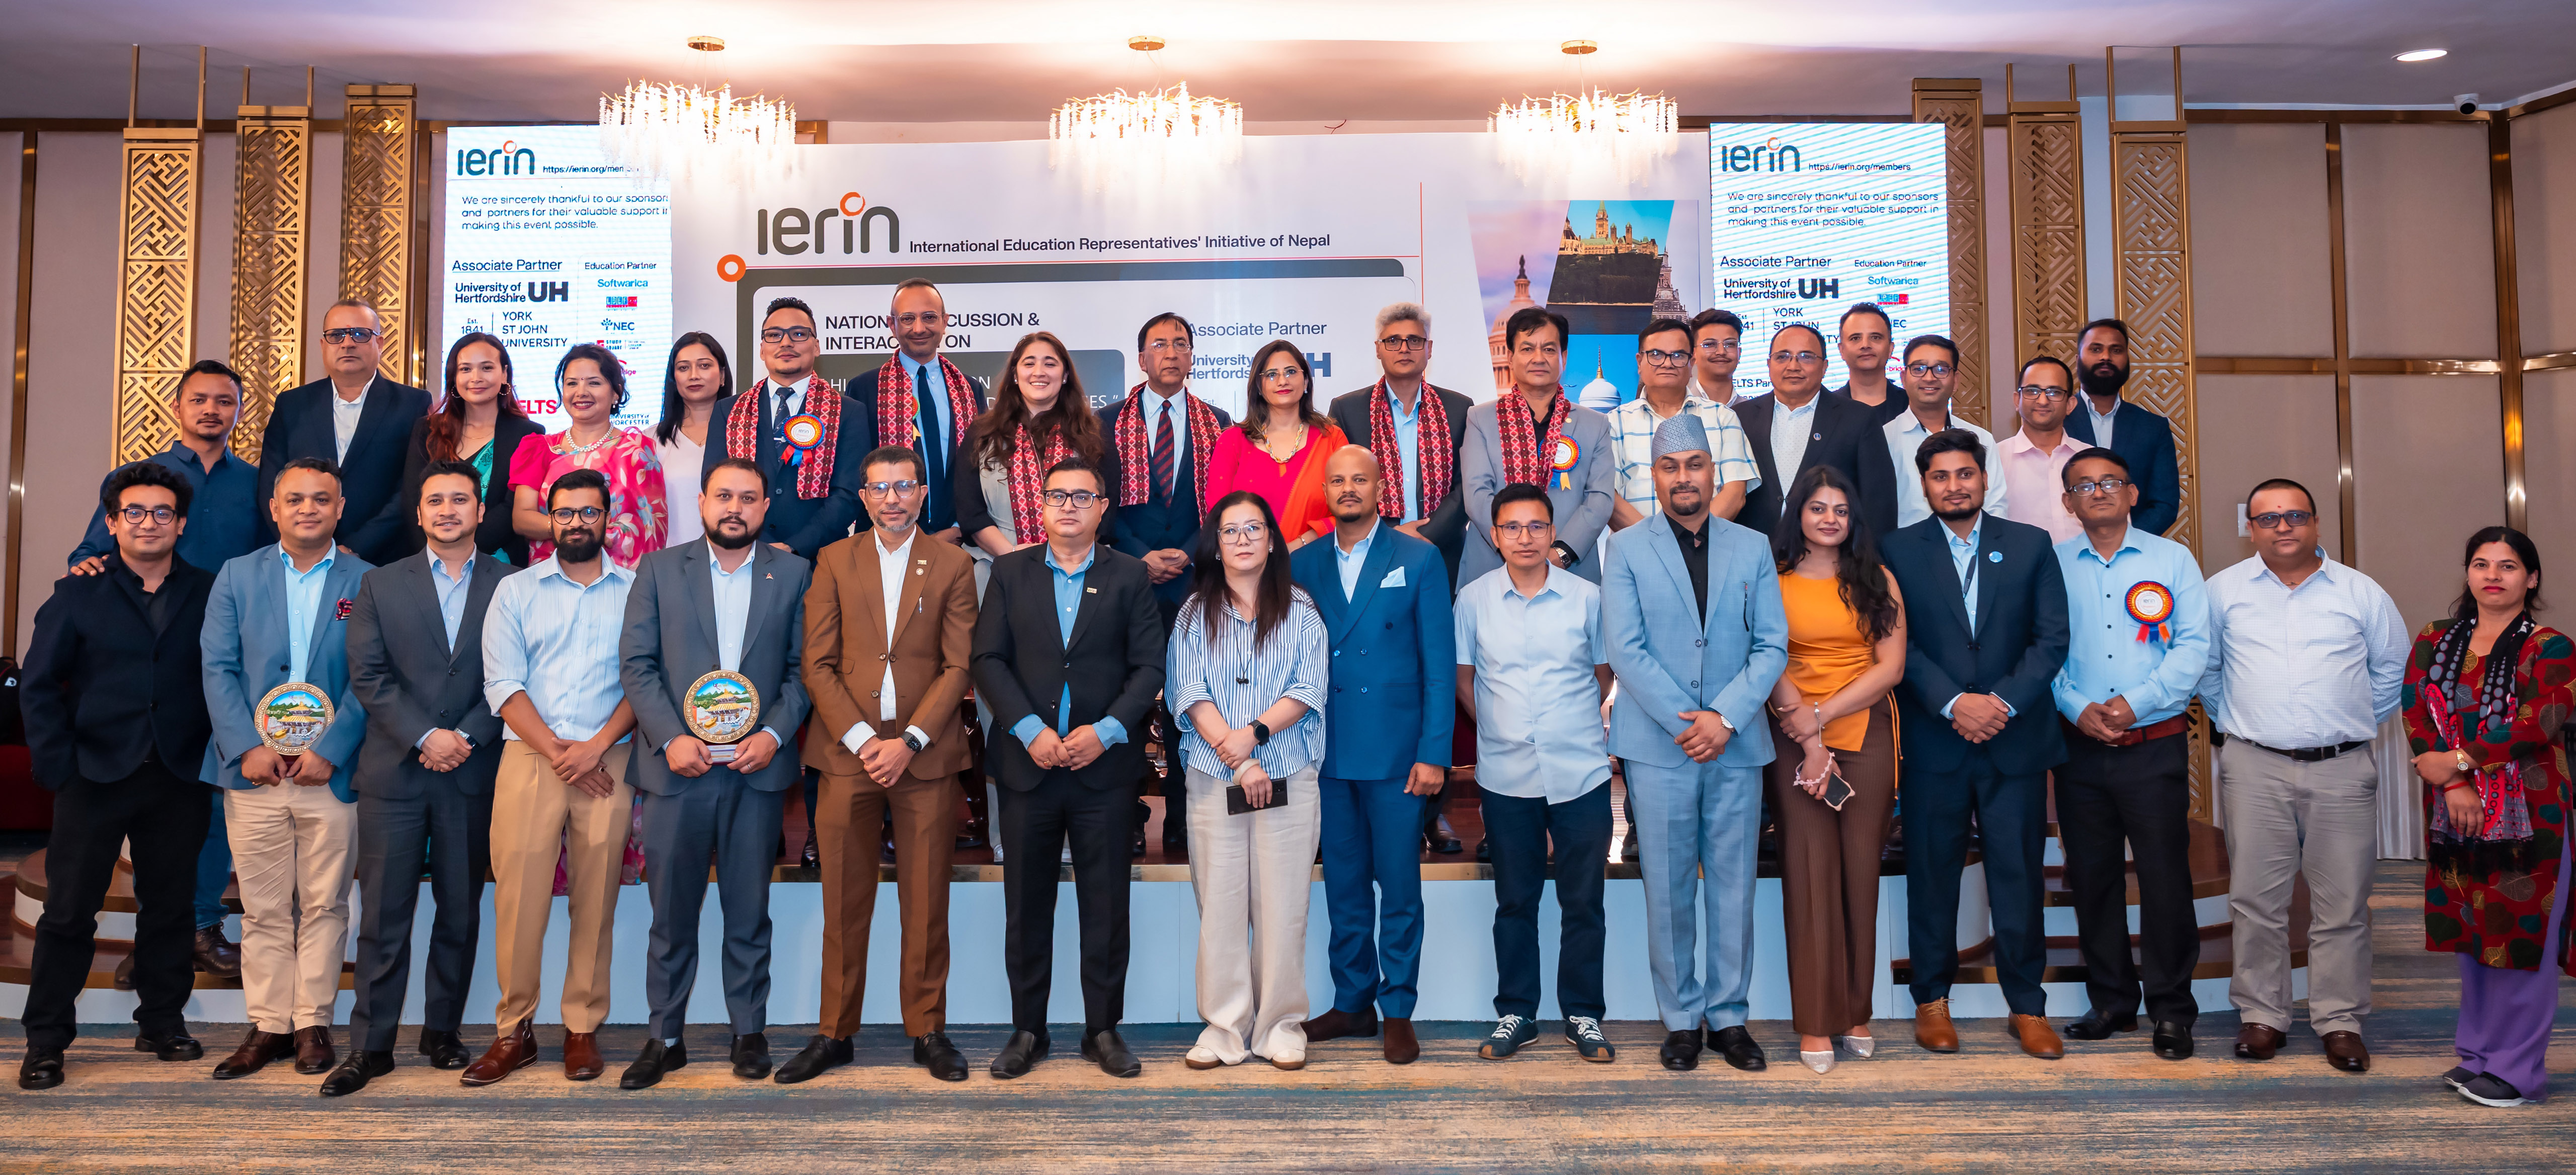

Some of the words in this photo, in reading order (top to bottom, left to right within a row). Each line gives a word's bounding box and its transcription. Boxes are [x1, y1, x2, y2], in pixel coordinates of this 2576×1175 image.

[1809, 163, 1911, 172] https://ierin.org/members
[501, 195, 545, 205] sincerely
[548, 195, 590, 203] thankful
[1767, 193, 1812, 202] sincerely
[1815, 192, 1857, 200] thankful
[1893, 193, 1938, 202] sponsors
[488, 209, 529, 218] partners
[532, 208, 546, 216] for
[549, 208, 572, 216] their
[575, 207, 617, 216] valuable
[620, 208, 660, 216] support
[1754, 206, 1797, 214] partners
[1799, 205, 1813, 213] for
[1816, 205, 1838, 213] their
[1842, 205, 1885, 213] valuable
[1888, 206, 1926, 214] support
[462, 221, 500, 231] making
[503, 221, 521, 229] this
[524, 221, 552, 229] event
[554, 220, 598, 231] possible.
[1728, 217, 1766, 227] making
[1770, 217, 1788, 225] this
[1823, 217, 1866, 227] possible.
[910, 239, 999, 253] International
[1003, 238, 1075, 251] Education
[1079, 236, 1201, 253] Representatives'
[1205, 235, 1265, 248] Initiative
[1270, 234, 1284, 247] of
[1289, 234, 1330, 249] Nepal
[452, 260, 513, 271] Associate
[517, 260, 562, 270] Partner
[1720, 256, 1781, 267] Associate
[1786, 256, 1831, 267] Partner
[597, 279, 648, 287] Softwarica
[1724, 278, 1778, 289] University
[1780, 278, 1791, 288] of
[1868, 277, 1918, 285] Softwarica
[455, 282, 508, 293] University
[510, 282, 521, 291] of
[528, 282, 569, 302] UH
[1798, 278, 1839, 299] UH
[455, 293, 526, 303] Hertfordshire
[1724, 289, 1796, 299] Hertfordshire
[503, 311, 532, 320] YORK
[1773, 308, 1803, 317] YORK
[826, 315, 889, 329] NATION
[947, 313, 1022, 326] CUSSION
[1028, 312, 1040, 326] &
[1774, 321, 1787, 330] ST
[1891, 319, 1906, 327] EC
[461, 325, 483, 334] 1841
[502, 325, 516, 334] ST
[518, 324, 547, 333] JOHN
[613, 322, 635, 330] NEC
[1190, 322, 1263, 337] Associate
[1269, 322, 1327, 335] Partner
[502, 338, 568, 347] UNIVERSITY
[826, 335, 899, 350] INTERAC
